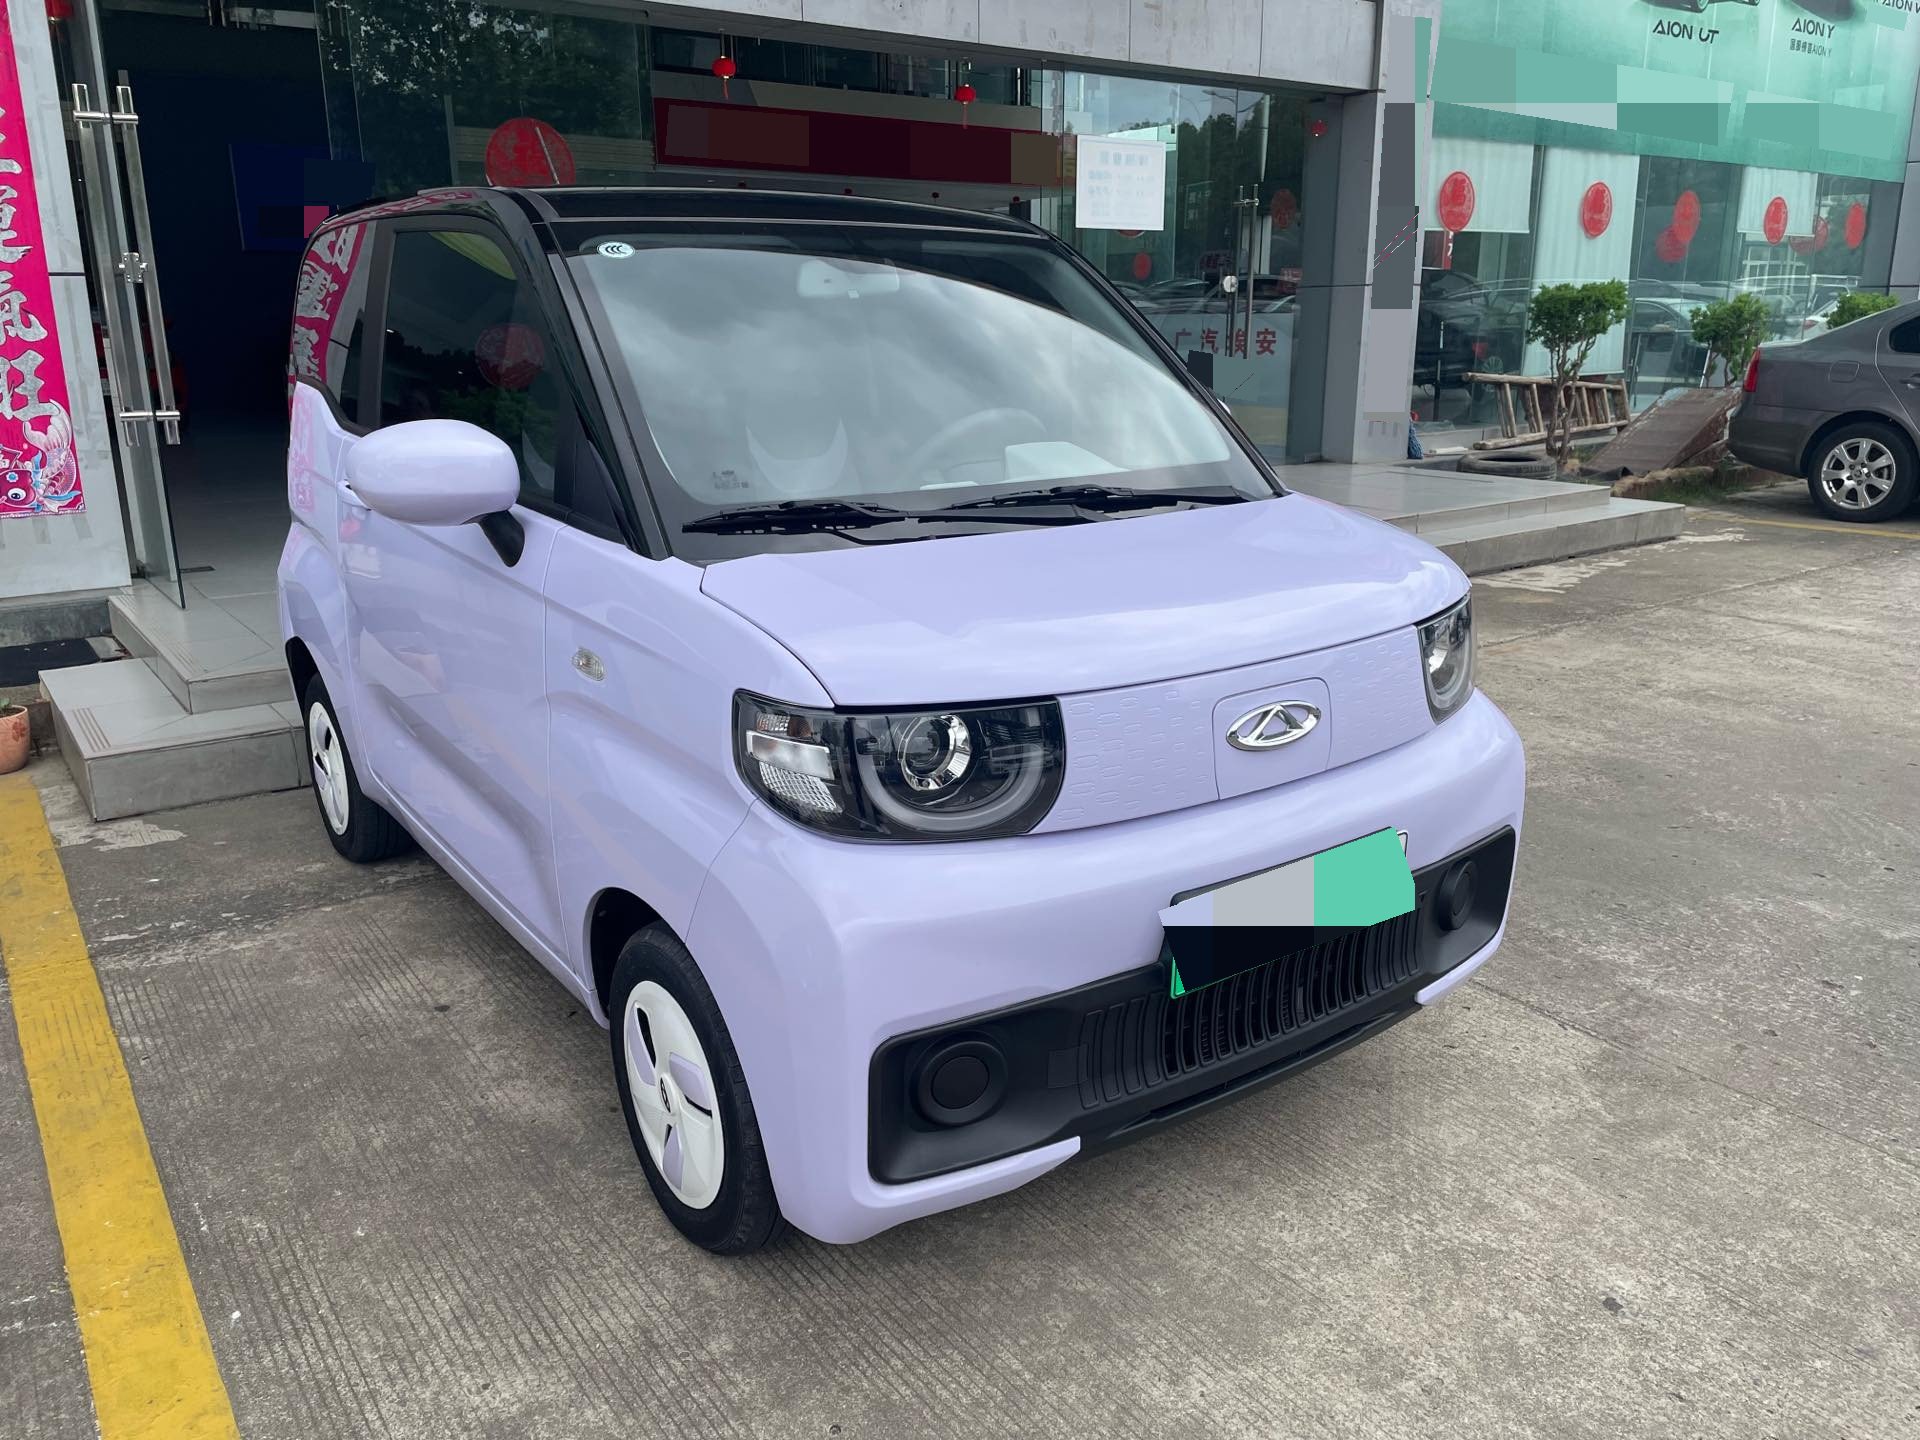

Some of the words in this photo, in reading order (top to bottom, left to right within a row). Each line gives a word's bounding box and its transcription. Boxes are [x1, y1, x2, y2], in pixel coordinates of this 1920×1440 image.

[1652, 19, 1693, 40] AION
[1698, 27, 1719, 44] UT
[1791, 17, 1825, 37] AION
[1827, 24, 1835, 39] Y
